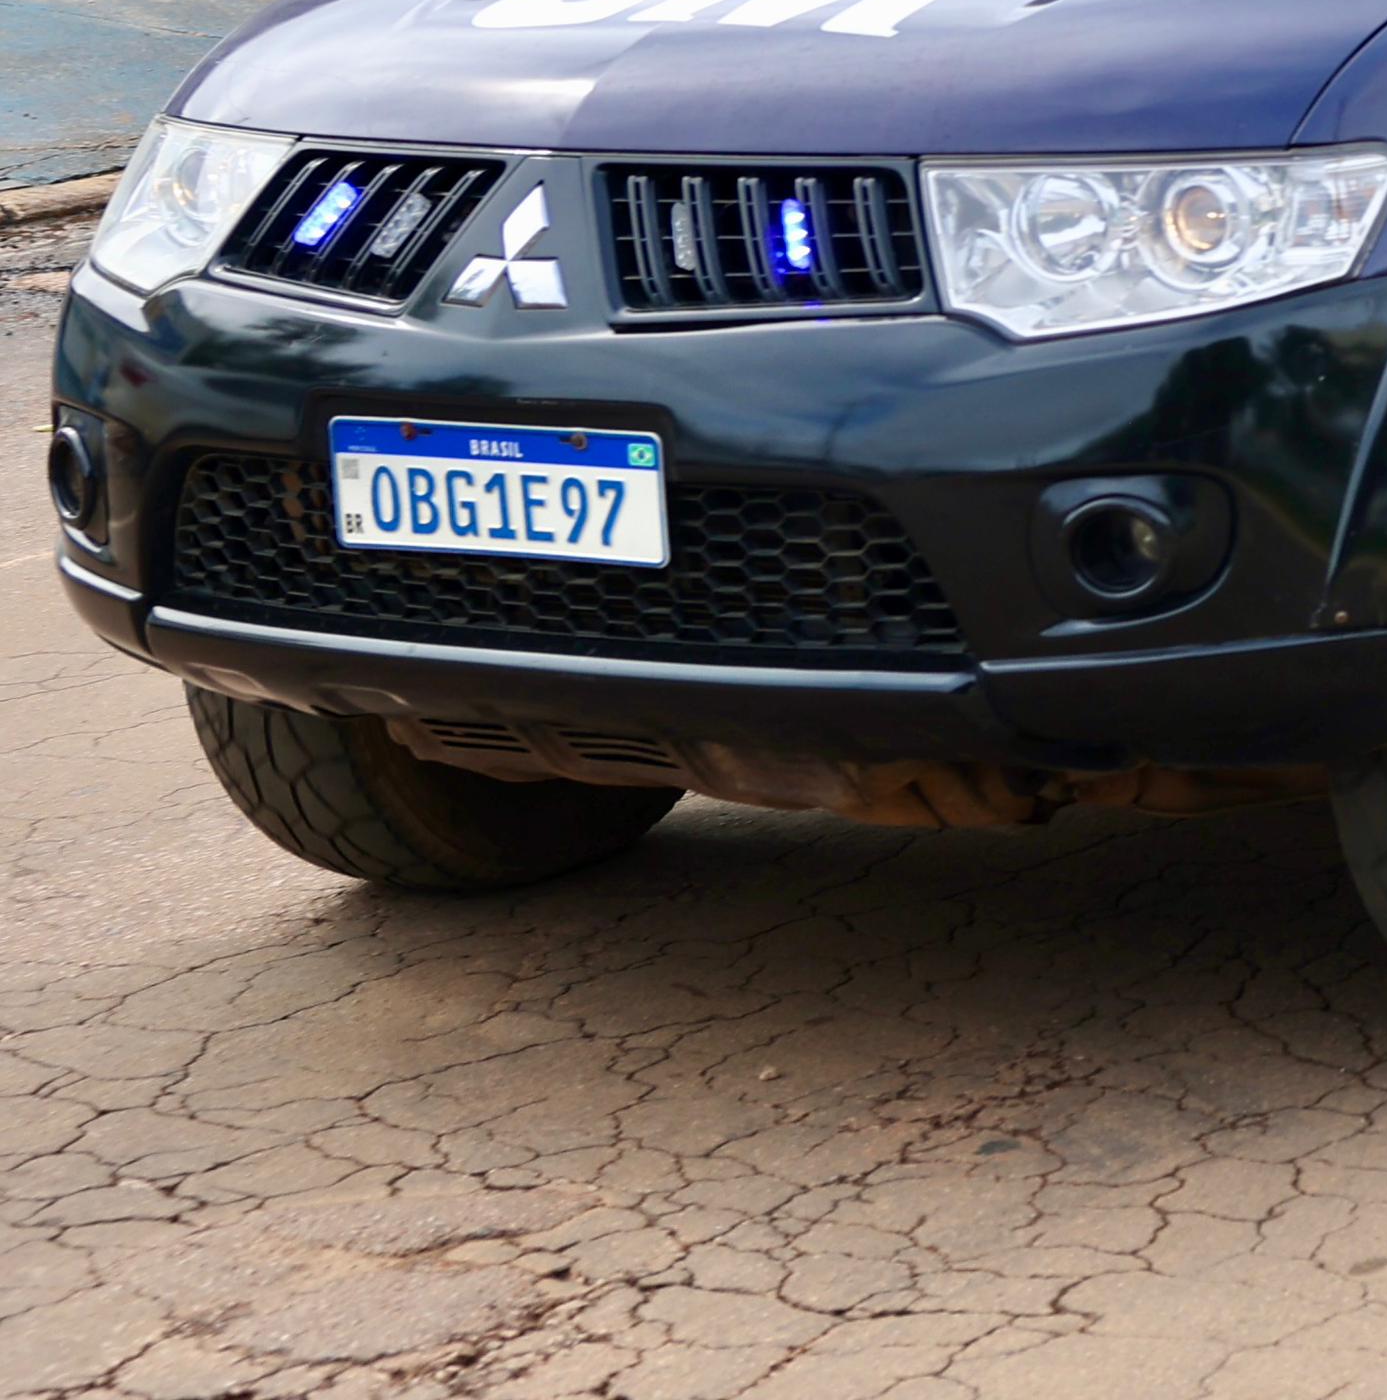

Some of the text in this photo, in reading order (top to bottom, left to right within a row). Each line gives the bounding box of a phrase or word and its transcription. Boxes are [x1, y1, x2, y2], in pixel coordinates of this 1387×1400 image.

[469, 438, 524, 459] BRASIL
[370, 465, 626, 547] OBG1E97
[345, 512, 364, 535] BR
